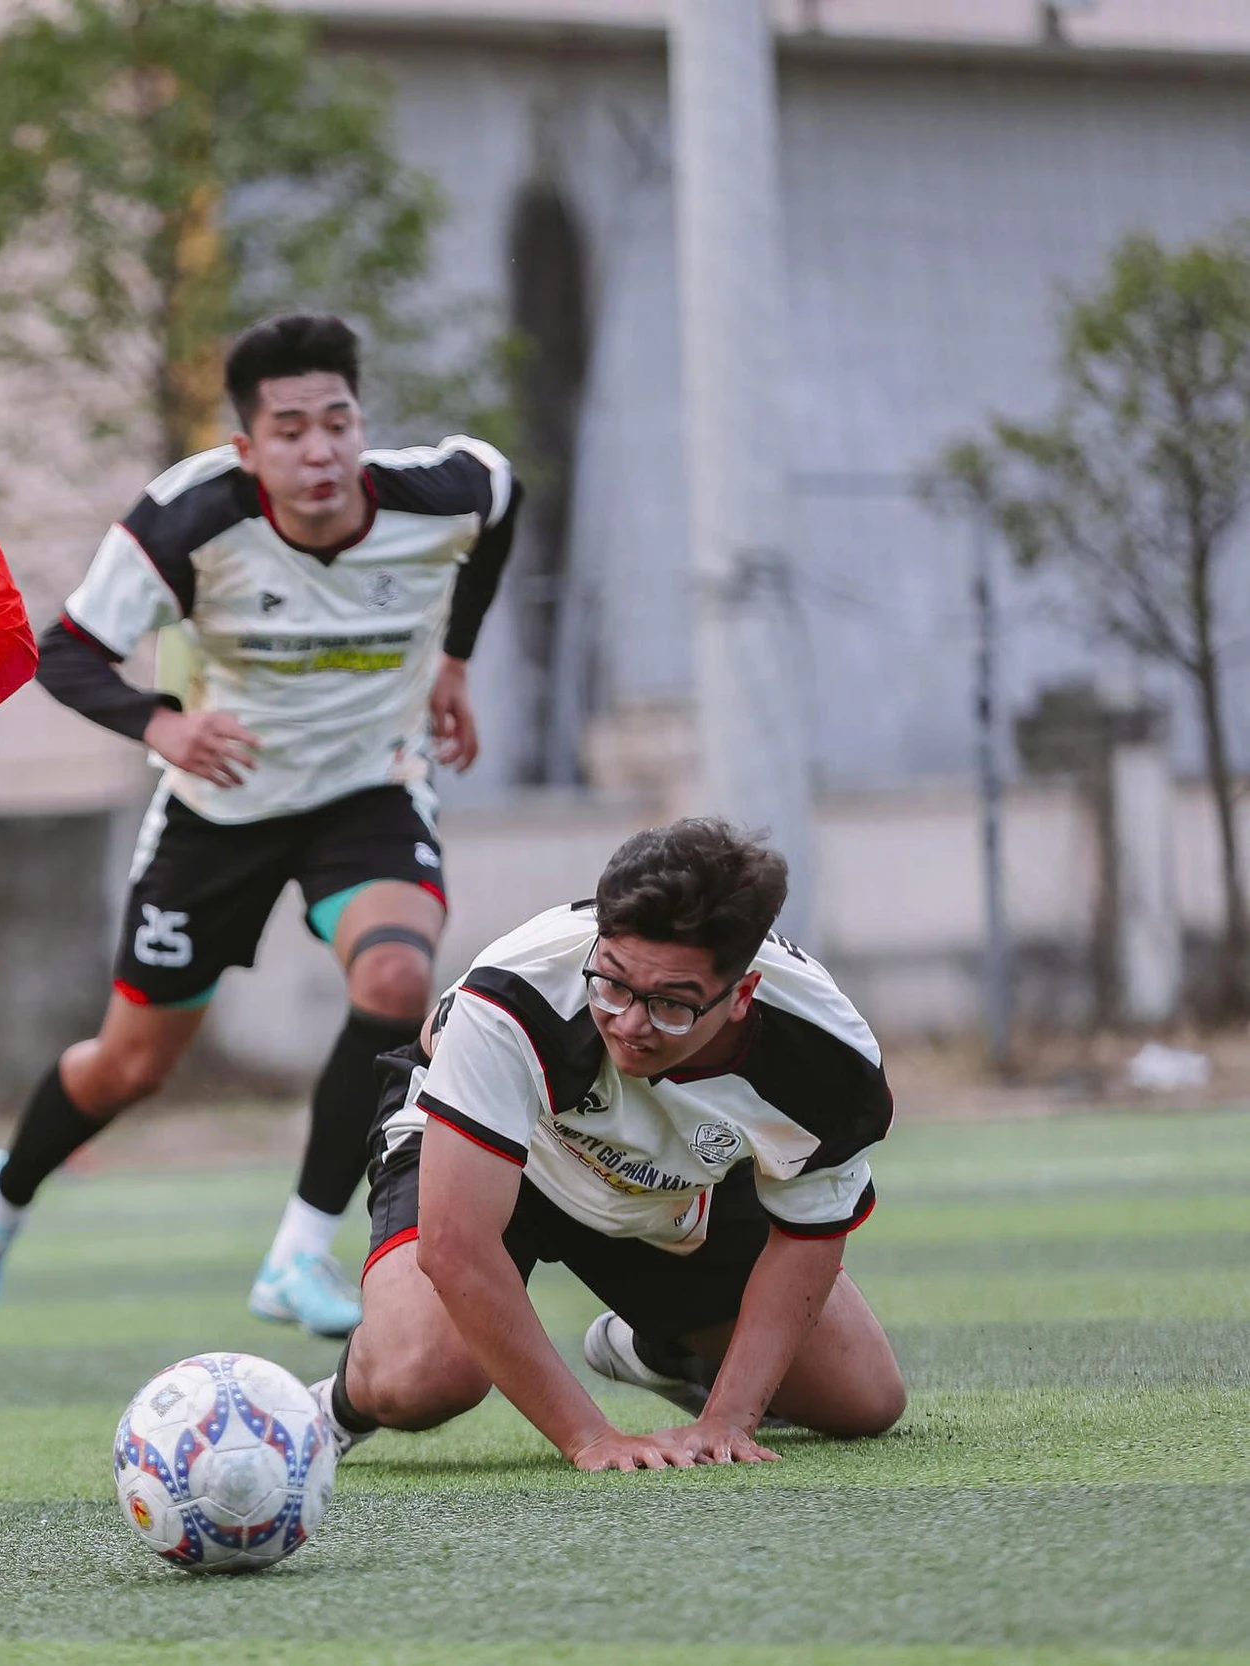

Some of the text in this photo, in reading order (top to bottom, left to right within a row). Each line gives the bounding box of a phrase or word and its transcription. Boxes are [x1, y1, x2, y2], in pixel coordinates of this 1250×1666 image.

[134, 903, 193, 968] 25
[581, 1135, 604, 1151] TY
[597, 1145, 627, 1169] CỔ
